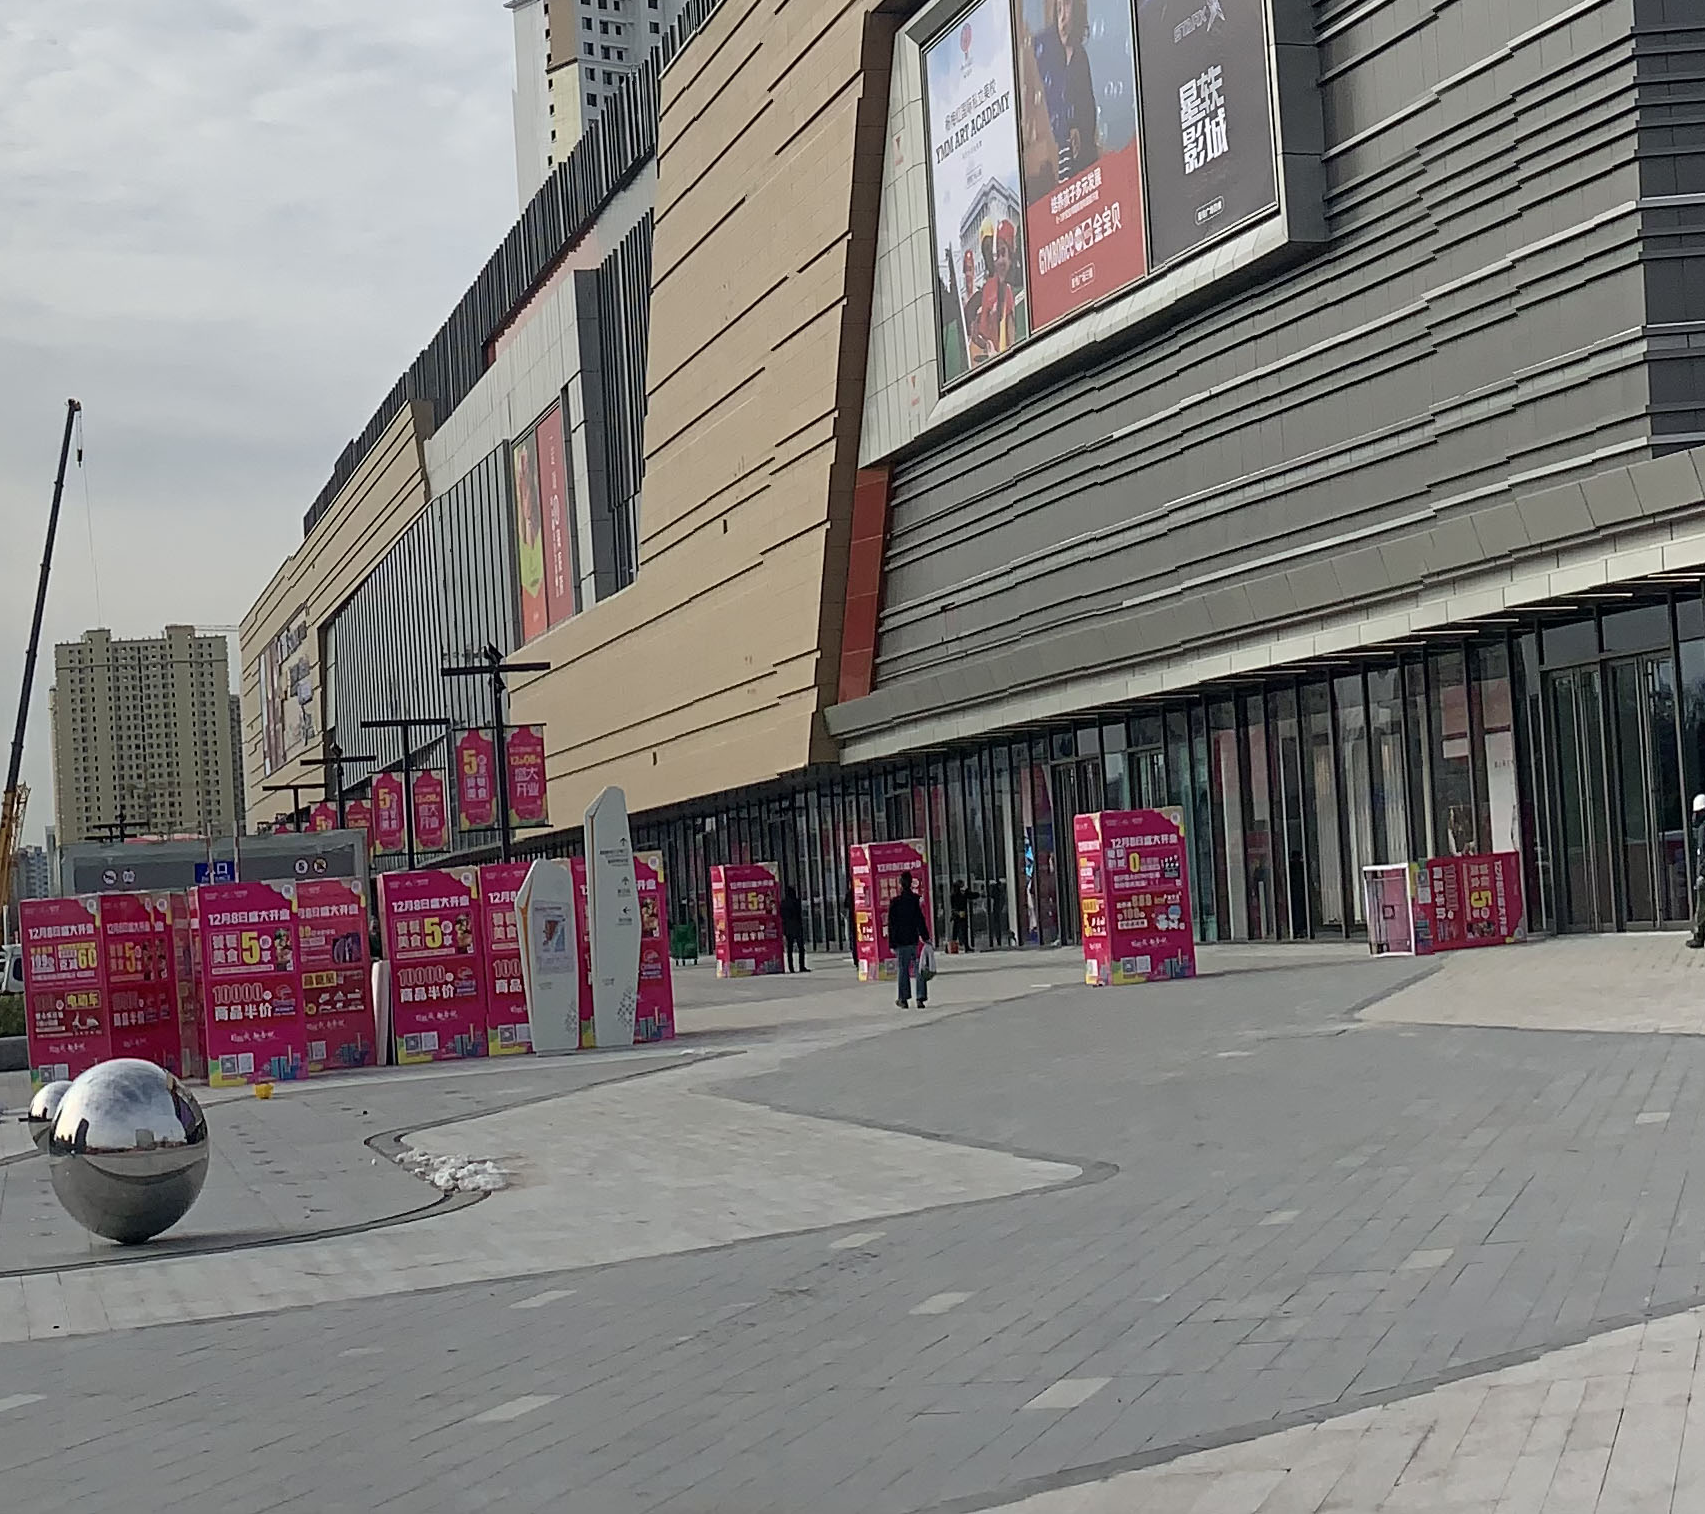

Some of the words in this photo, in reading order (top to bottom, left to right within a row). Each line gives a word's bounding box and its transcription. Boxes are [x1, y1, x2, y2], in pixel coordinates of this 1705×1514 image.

[955, 124, 971, 150] ART
[970, 91, 1010, 137] ACADEMY
[1093, 201, 1122, 243] 金宝贝
